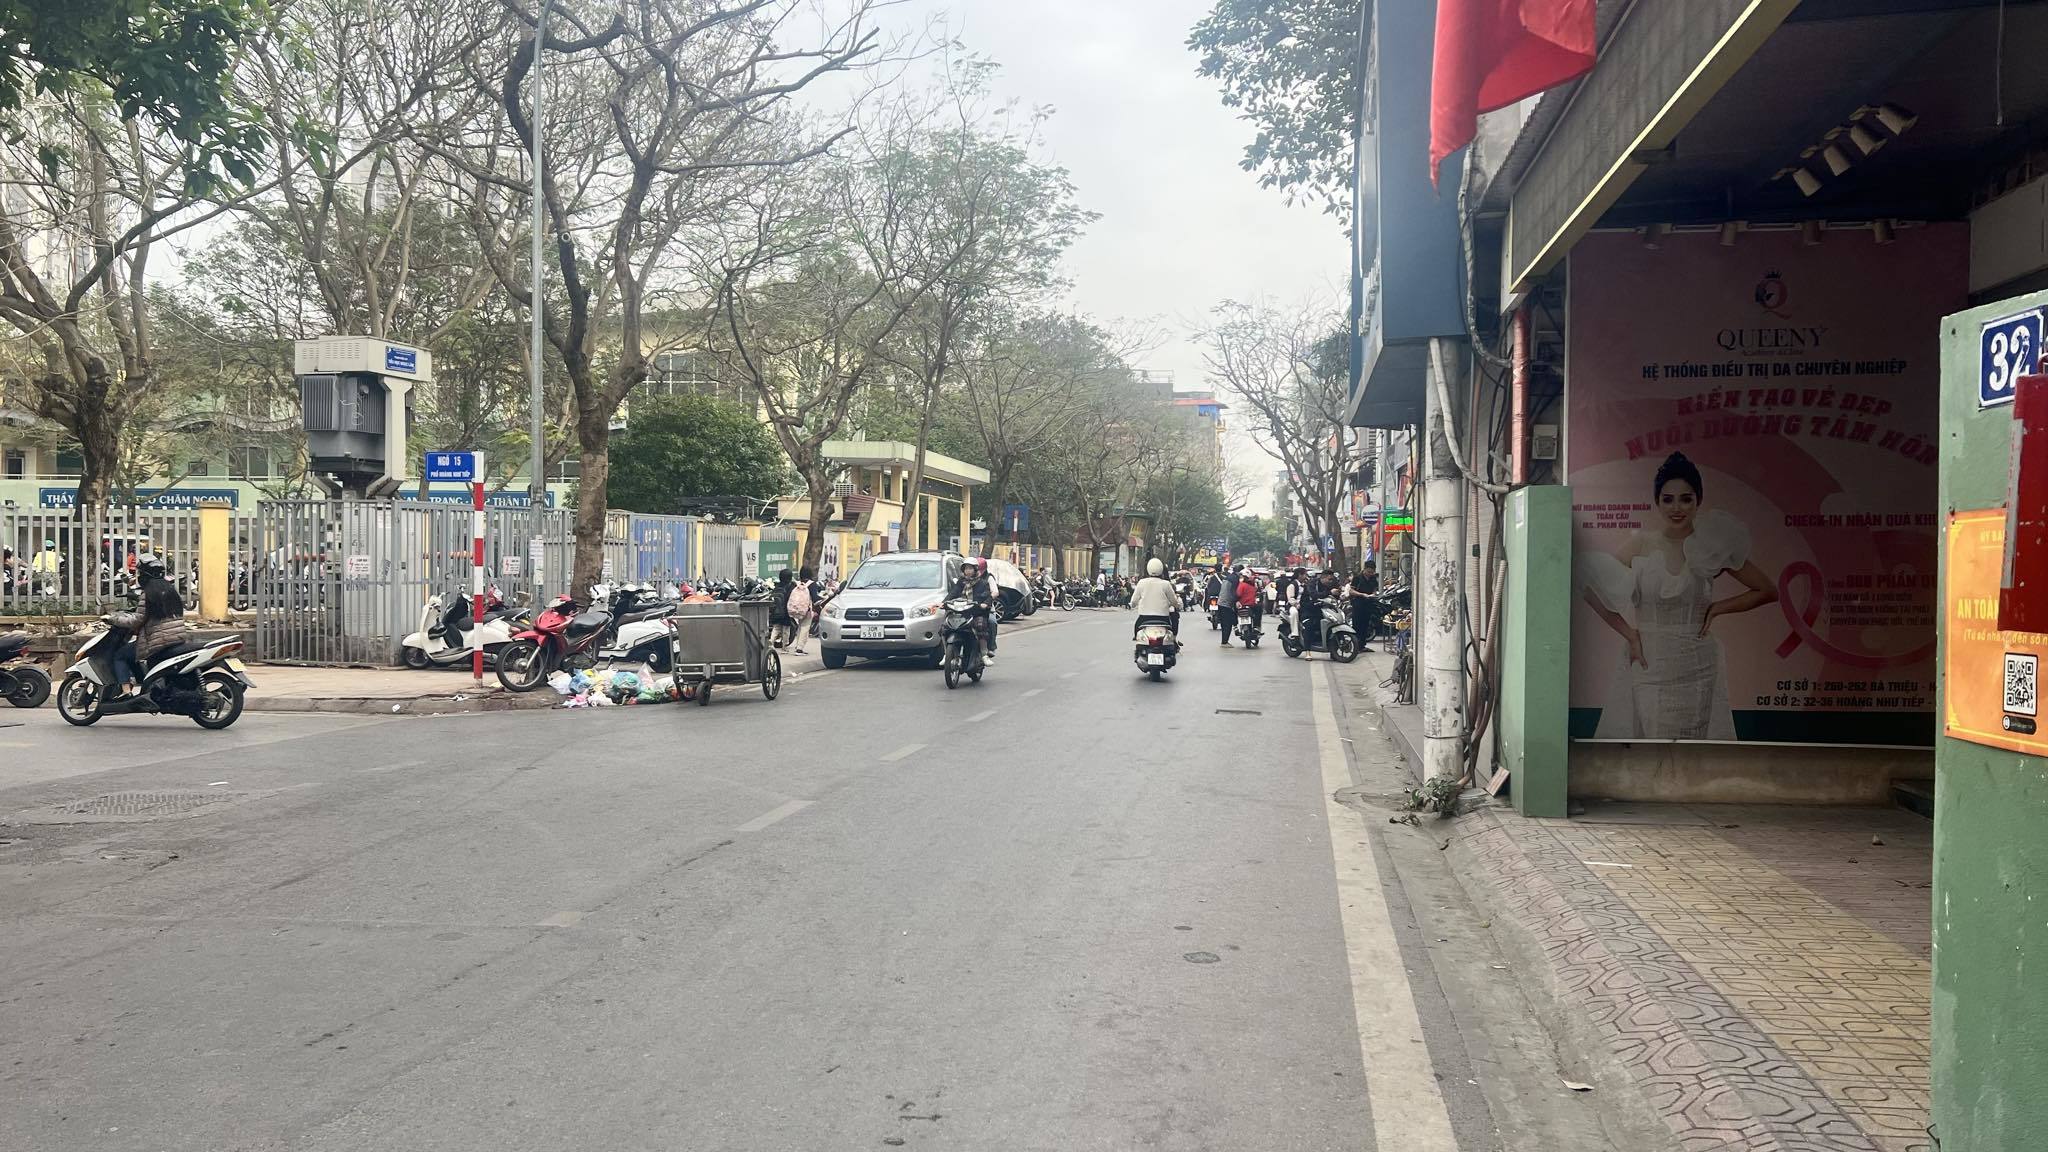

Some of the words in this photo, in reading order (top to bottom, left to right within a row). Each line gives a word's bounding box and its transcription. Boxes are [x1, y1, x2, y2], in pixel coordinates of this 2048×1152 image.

[1716, 327, 1829, 351] QUEENY
[1989, 325, 2031, 391] 32
[1642, 363, 1659, 381] HỆ
[1664, 360, 1708, 378] THỐNG
[1748, 363, 1768, 379] TRỊ
[1773, 363, 1791, 376] DA
[1795, 360, 1850, 376] CHUYÊN
[1854, 358, 1907, 377] NGHIỆP
[1748, 388, 1794, 411] TẠO
[1839, 393, 1893, 418] ĐẸP
[1810, 413, 1877, 444] TÂM
[454, 456, 461, 466] 15
[159, 494, 190, 504] CHĂM
[492, 495, 520, 506] THÂN
[1784, 514, 1842, 527] CHECK-IN
[1957, 599, 1971, 619] AN
[1756, 696, 1770, 706] CƠ
[1773, 693, 1788, 706] SỞ
[1791, 697, 1801, 706] 2:
[1836, 695, 1873, 707] HOÀNG
